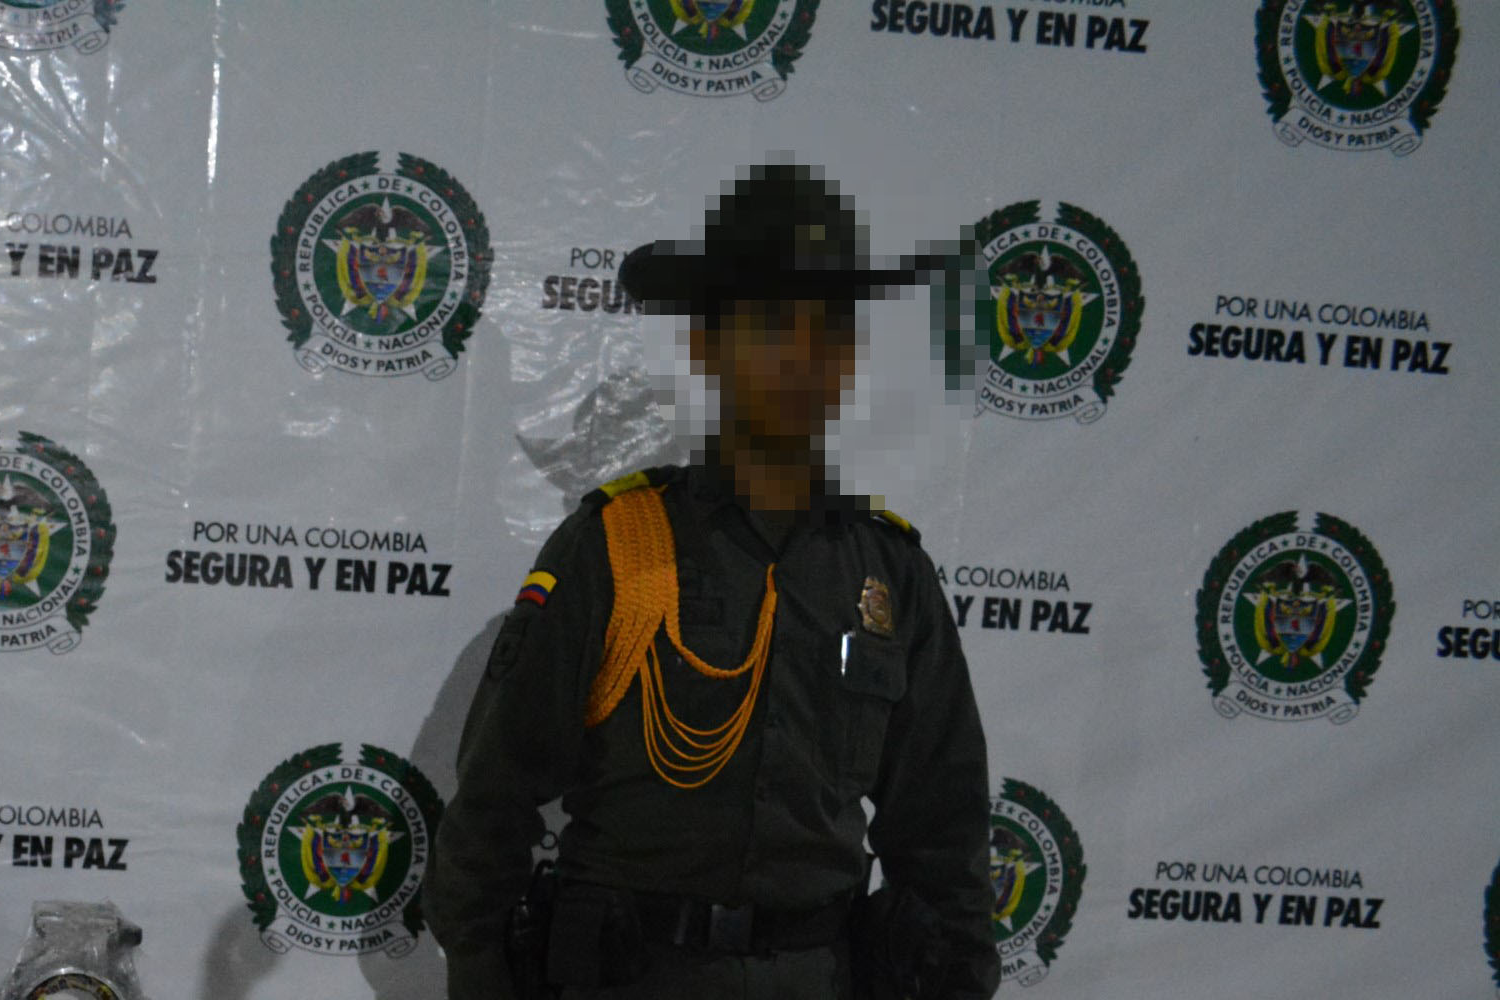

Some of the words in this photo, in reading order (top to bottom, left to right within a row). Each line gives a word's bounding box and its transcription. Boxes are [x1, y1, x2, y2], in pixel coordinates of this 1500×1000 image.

[709, 23, 785, 69] NACIONAL
[871, 0, 995, 40] SEGURA
[1007, 9, 1028, 42] Y
[1036, 11, 1077, 46] EN
[1086, 16, 1151, 53] PAZ
[707, 71, 762, 91] PATRIA
[378, 178, 400, 190] DE
[419, 191, 465, 281] COLOMBIA
[6, 243, 28, 276] Y
[39, 244, 80, 279] EN
[91, 247, 159, 284] PAZ
[570, 248, 615, 270] POR
[379, 303, 455, 349] NACIONAL
[1216, 296, 1257, 318] POR
[1264, 300, 1312, 322] UNA
[1318, 305, 1430, 330] COLOMBIA
[377, 350, 432, 371] PATRIA
[1188, 323, 1305, 363] SEGURA
[1317, 333, 1336, 365] Y
[1344, 335, 1383, 369] EN
[1391, 338, 1452, 374] PAZ
[193, 522, 238, 543] POR
[246, 525, 298, 546] UNA
[305, 528, 428, 552] COLOMBIA
[166, 550, 293, 588] SEGURA
[304, 558, 326, 590] Y
[336, 559, 377, 592] EN
[387, 561, 452, 596] PAZ
[954, 567, 1070, 591] COLOMBIA
[1296, 535, 1316, 547] DE
[1332, 547, 1370, 632] COLOMBIA
[953, 595, 974, 626] Y
[981, 597, 1022, 629] EN
[1030, 600, 1093, 634] PAZ
[1288, 652, 1359, 696] NACIONAL
[1285, 696, 1335, 716] PATRIA
[341, 768, 363, 780] DE
[381, 780, 425, 864] COLOMBIA
[13, 834, 53, 867] EN
[64, 837, 129, 870] PAZ
[1155, 862, 1196, 881] POR
[1202, 864, 1248, 883] UNA
[1254, 867, 1363, 888] COLOMBIA
[342, 885, 416, 930] NACIONAL
[1128, 888, 1241, 923] SEGURA
[1253, 894, 1272, 924] Y
[1279, 895, 1317, 926] EN
[1324, 897, 1384, 928] PAZ
[340, 930, 393, 950] PATRIA
